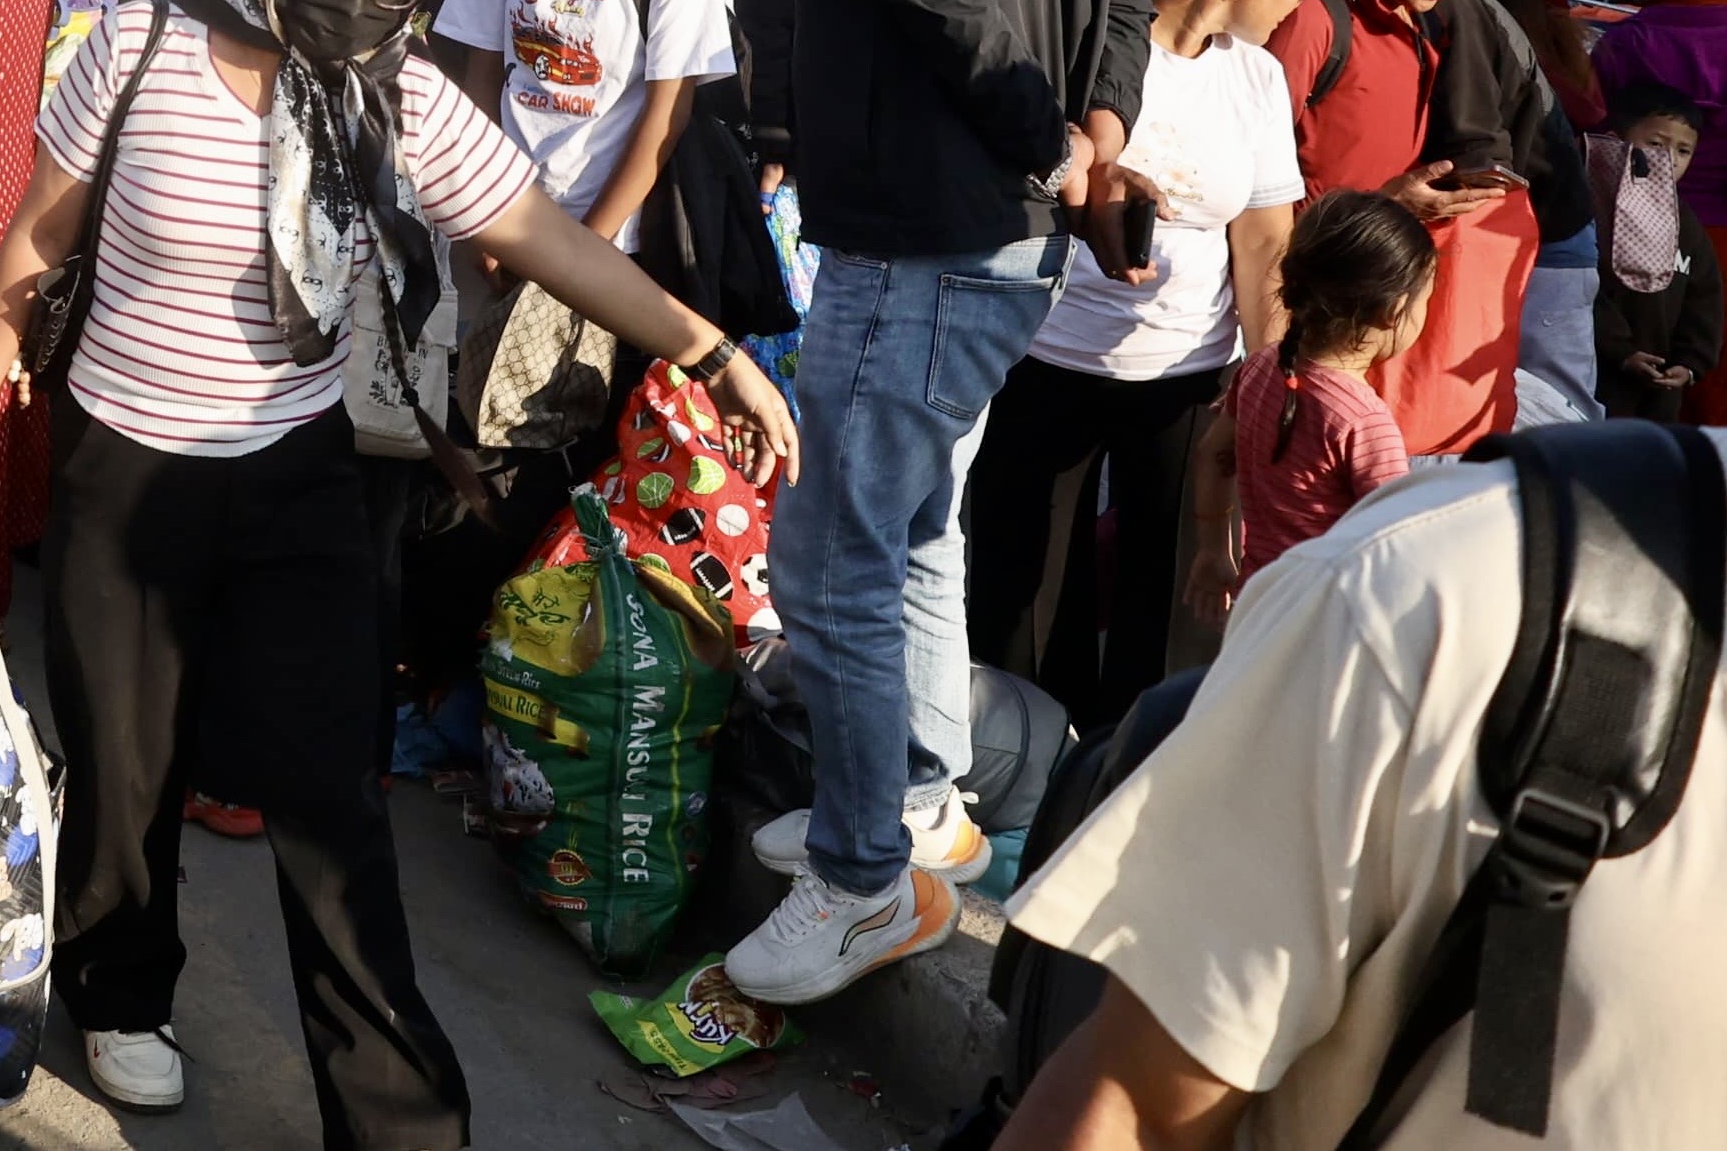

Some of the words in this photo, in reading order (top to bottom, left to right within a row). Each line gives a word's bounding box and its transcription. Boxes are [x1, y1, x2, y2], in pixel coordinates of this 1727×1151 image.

[517, 91, 549, 110] CAR
[552, 91, 596, 117] SHOW
[625, 593, 658, 671] SONA
[622, 813, 653, 883] RICE
